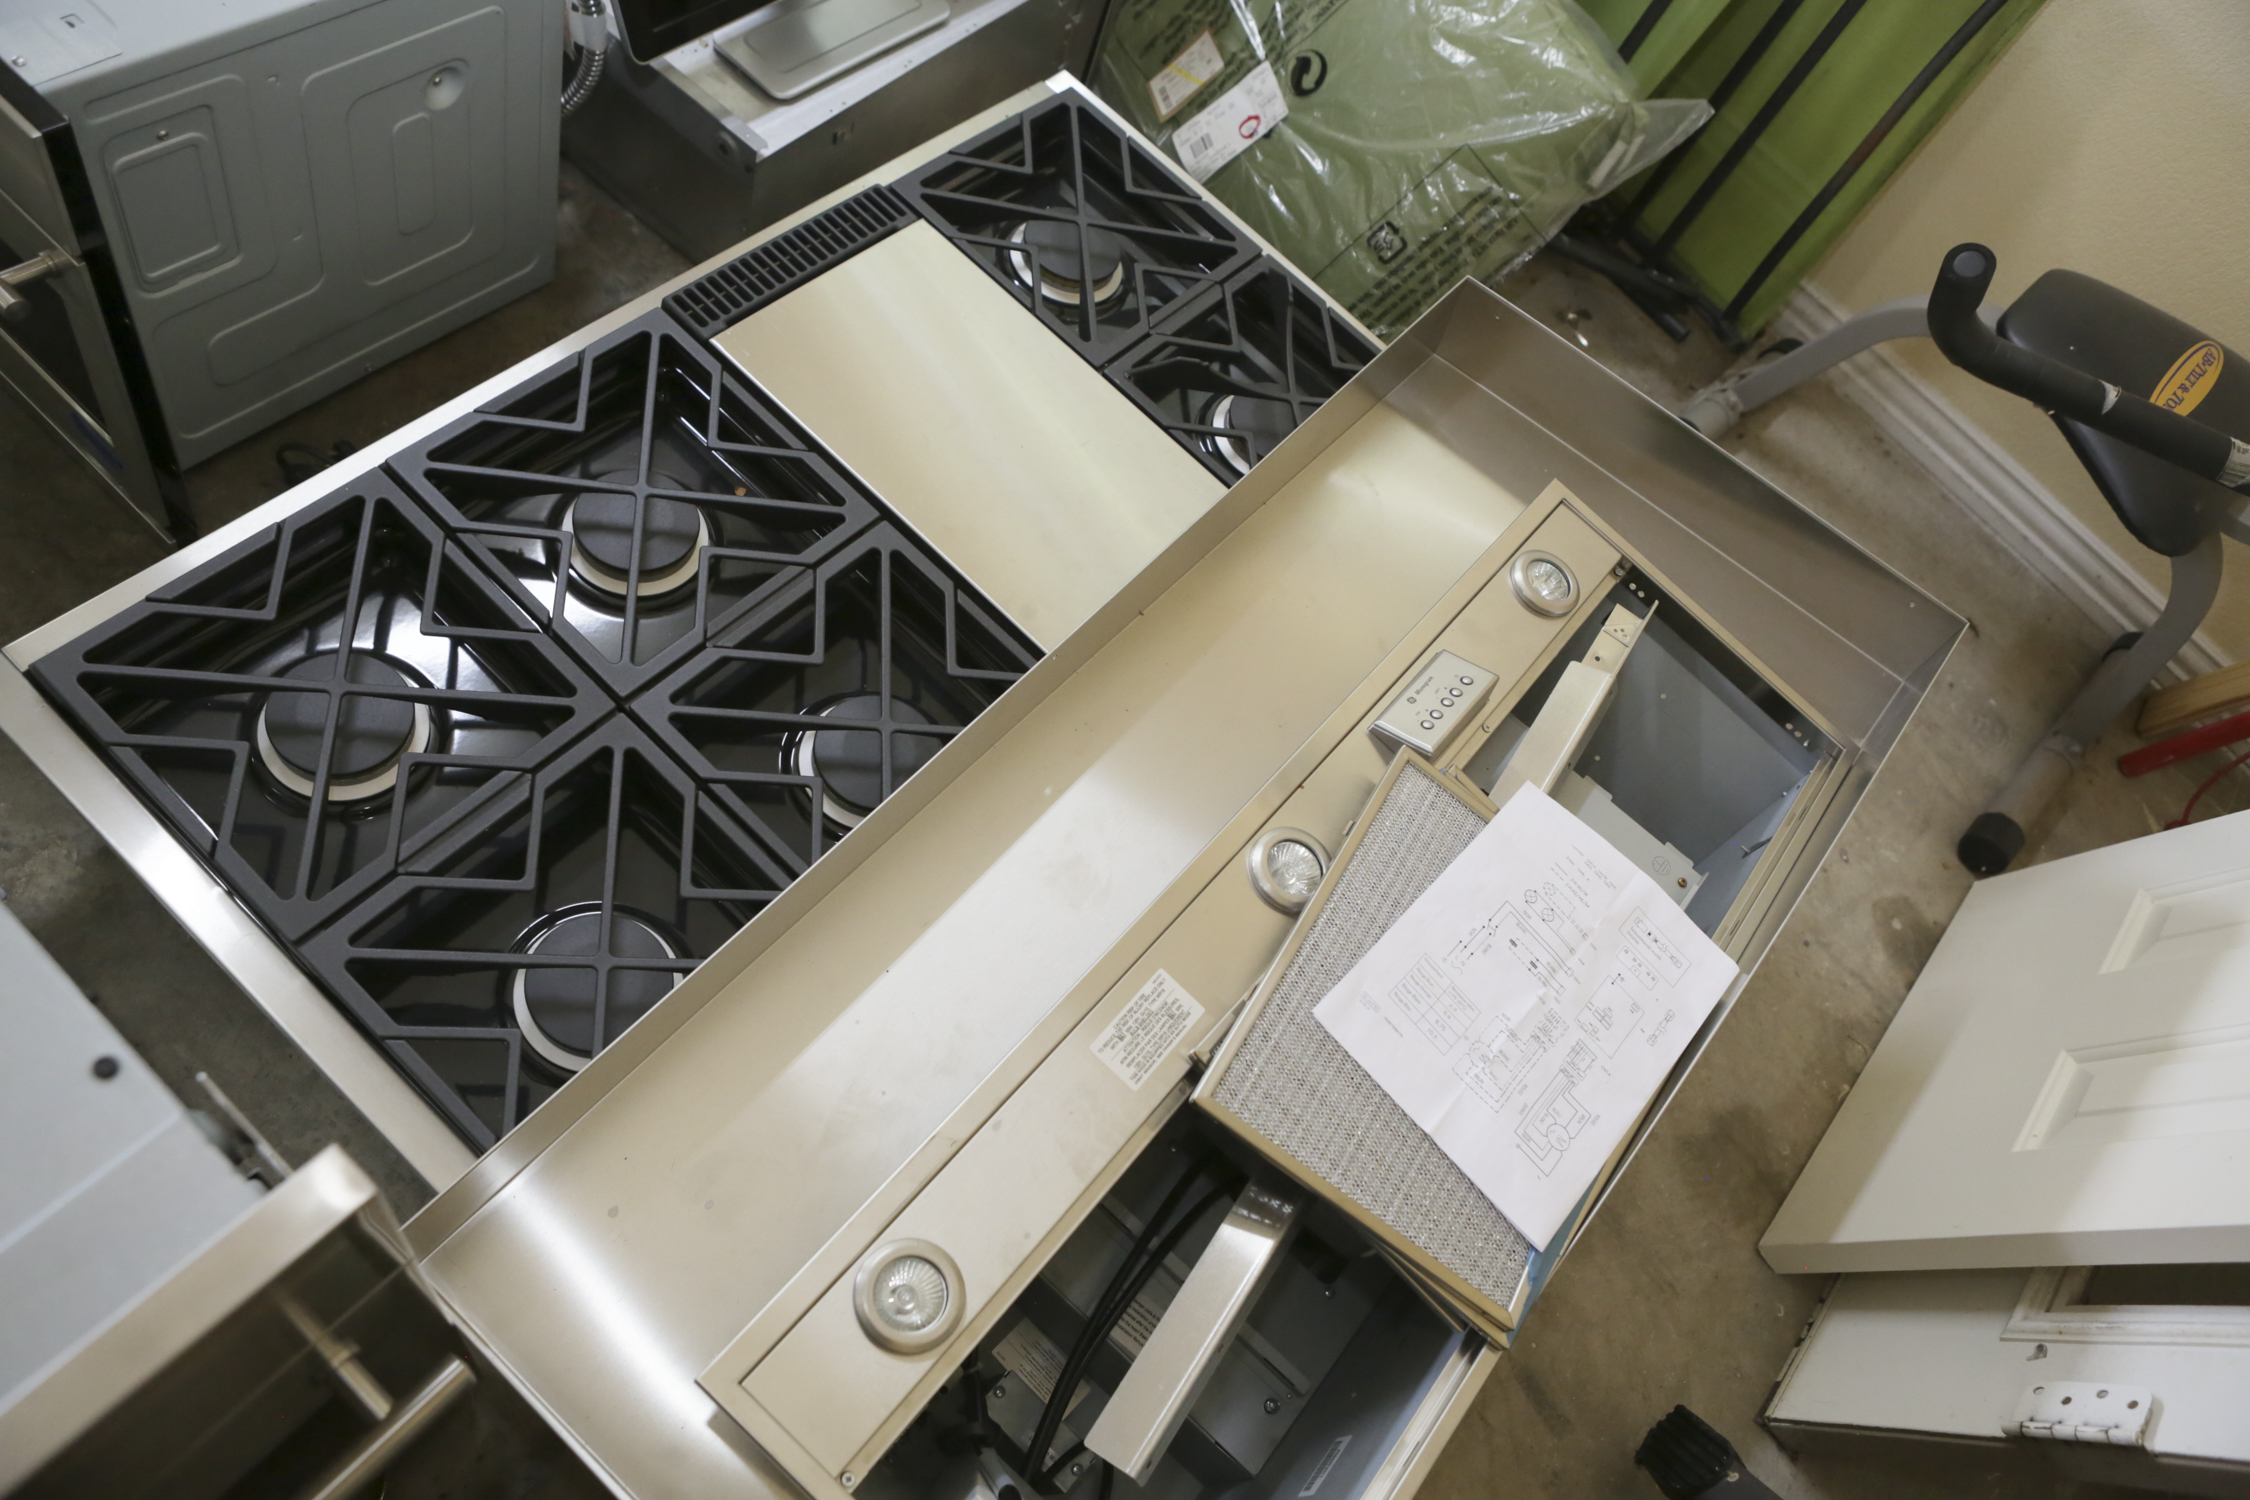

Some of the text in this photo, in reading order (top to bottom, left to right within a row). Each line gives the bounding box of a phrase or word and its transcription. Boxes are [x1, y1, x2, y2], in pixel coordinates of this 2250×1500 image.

[2177, 383, 2190, 393] &
[1415, 675, 1434, 696] Monogram
[1097, 1046, 1104, 1054] TO
[1102, 1033, 1117, 1049] REDUCE
[1114, 1026, 1123, 1035] THE
[1120, 1017, 1130, 1028] RISK
[1132, 1001, 1145, 1015] INJURY
[1142, 986, 1158, 1003] REPLACE
[1156, 977, 1166, 988] ONLY
[1112, 1013, 1128, 1029] CAUTION
[1125, 1005, 1135, 1014] RISK
[1137, 992, 1146, 1001] FIRE
[1147, 996, 1157, 1007] TYPE
[1121, 1032, 1141, 1052] ATTENTION
[1140, 1017, 1153, 1032] RISQUE
[1143, 1023, 1156, 1037] RISQUE
[1153, 1016, 1162, 1025] DES
[1125, 1045, 1146, 1068] REMPLACER
[1143, 1037, 1152, 1047] PAR
[1150, 1031, 1158, 1039] DES
[1156, 1017, 1170, 1033] LAMPES
